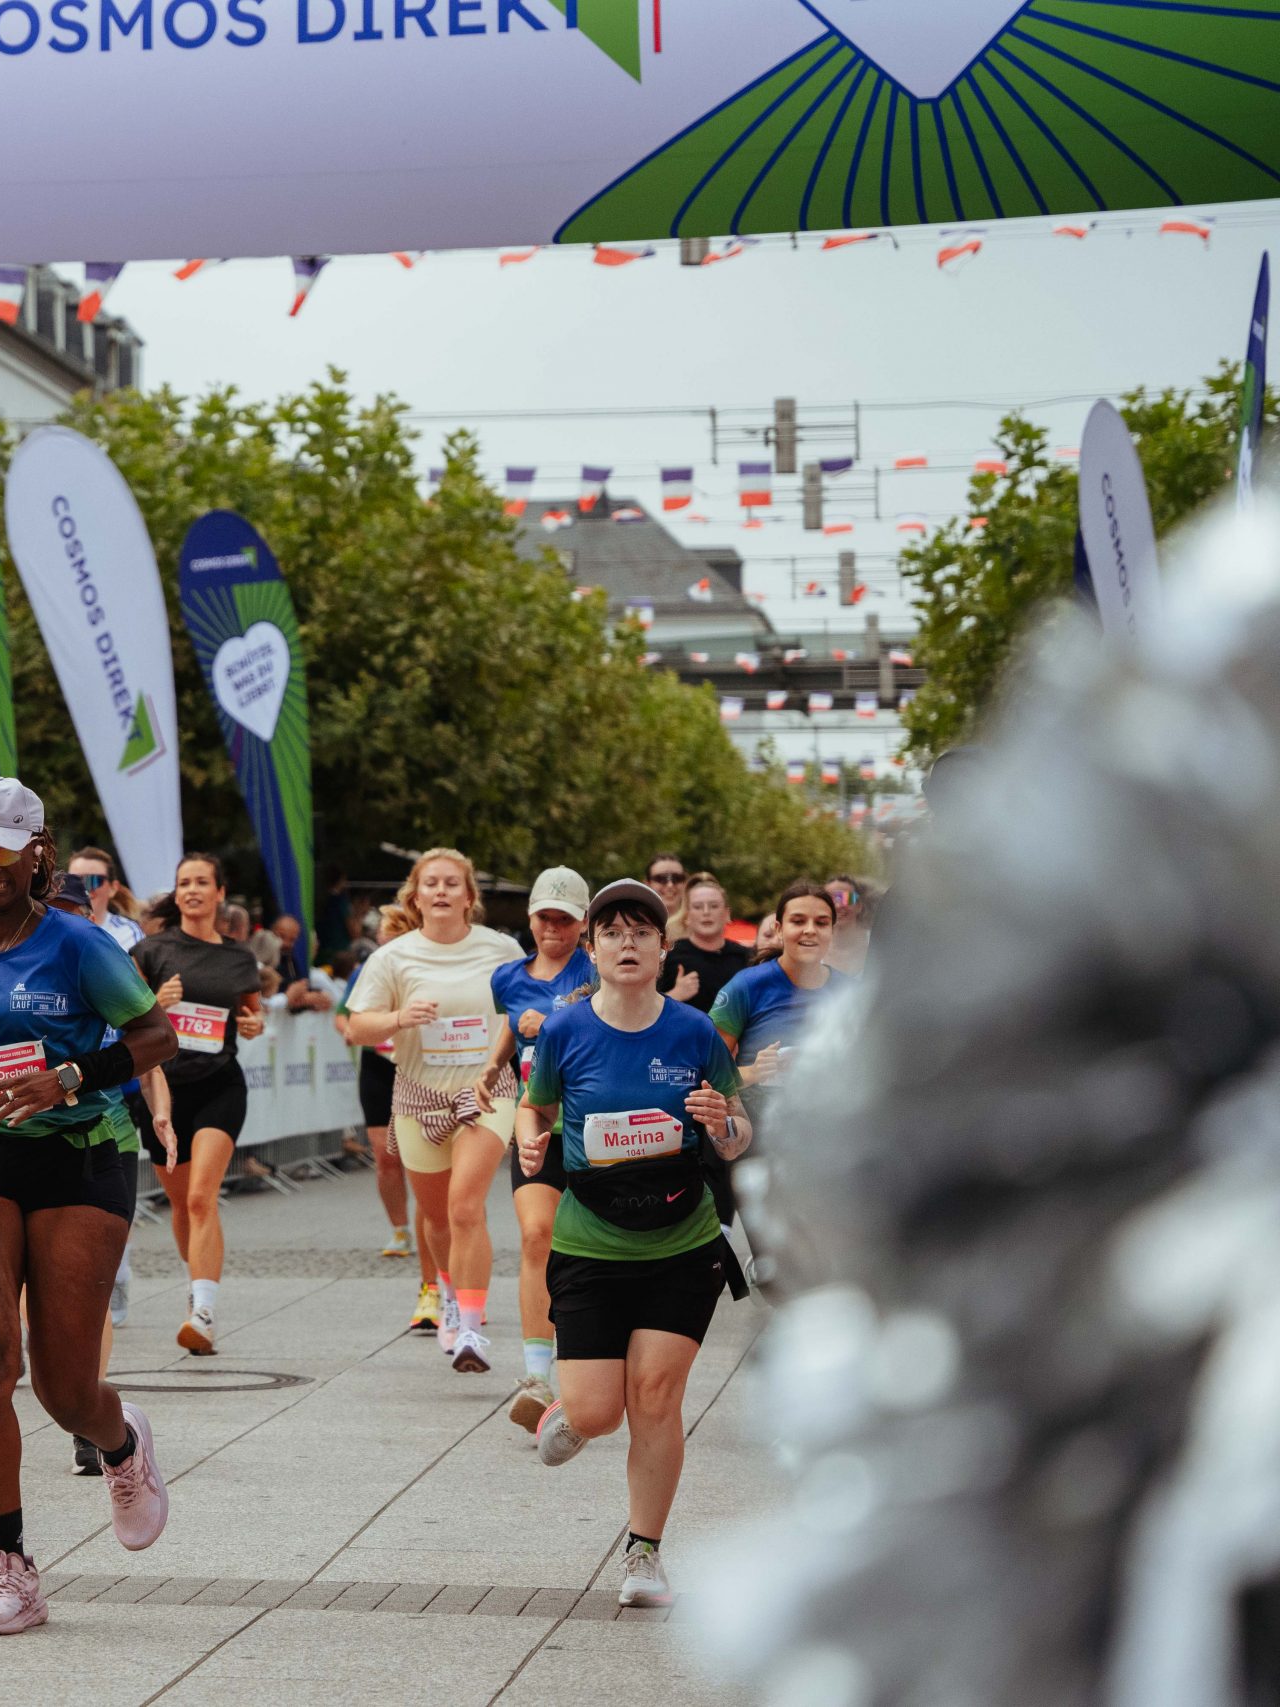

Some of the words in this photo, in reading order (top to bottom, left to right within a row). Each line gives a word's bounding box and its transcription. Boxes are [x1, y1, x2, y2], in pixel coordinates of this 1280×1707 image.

[52, 496, 105, 626] COSMOS
[96, 632, 144, 741] DIREKT
[12, 1001, 31, 1009] LAUF
[177, 1016, 213, 1035] 1762
[441, 1031, 470, 1042] Jana
[604, 1130, 665, 1147] Marina
[626, 1148, 646, 1157] 1041
